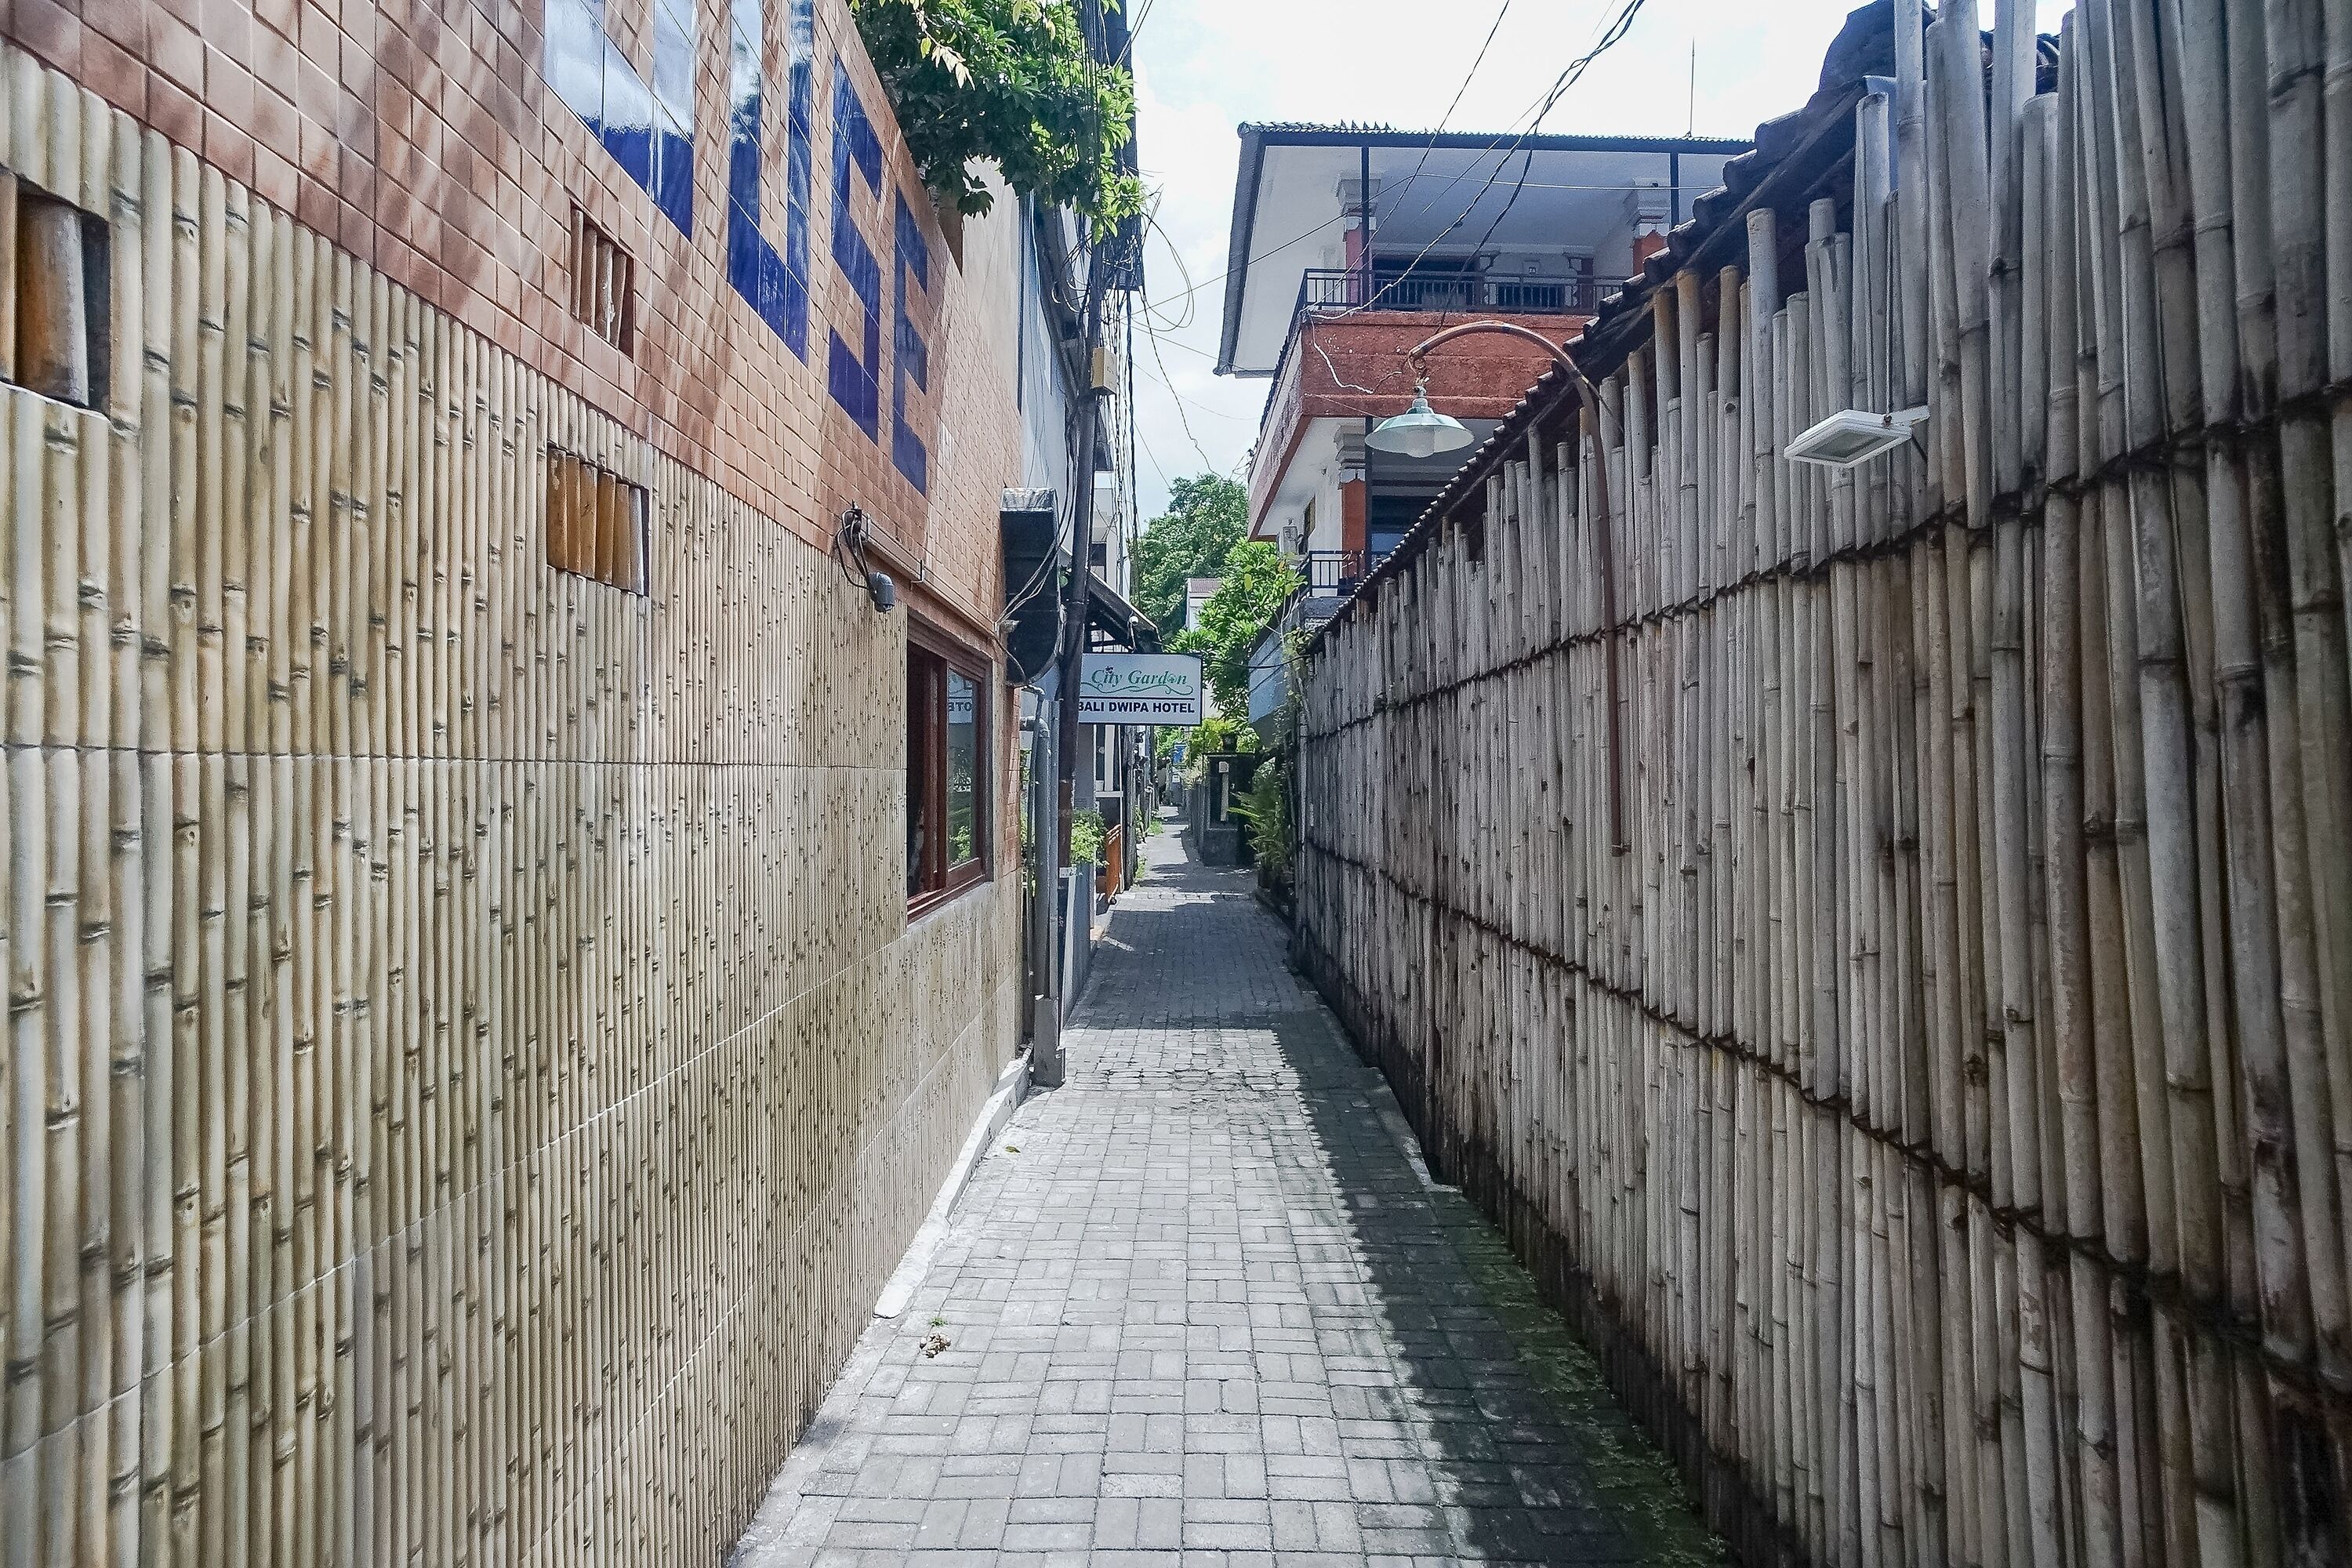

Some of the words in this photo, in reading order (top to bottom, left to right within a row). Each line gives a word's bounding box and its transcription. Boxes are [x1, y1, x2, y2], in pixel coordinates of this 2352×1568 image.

[1091, 667, 1123, 687] City
[1127, 670, 1187, 685] Garden
[1078, 701, 1105, 712] BALI
[1109, 702, 1149, 713] DWIPA
[1152, 702, 1195, 713] HOTEL
